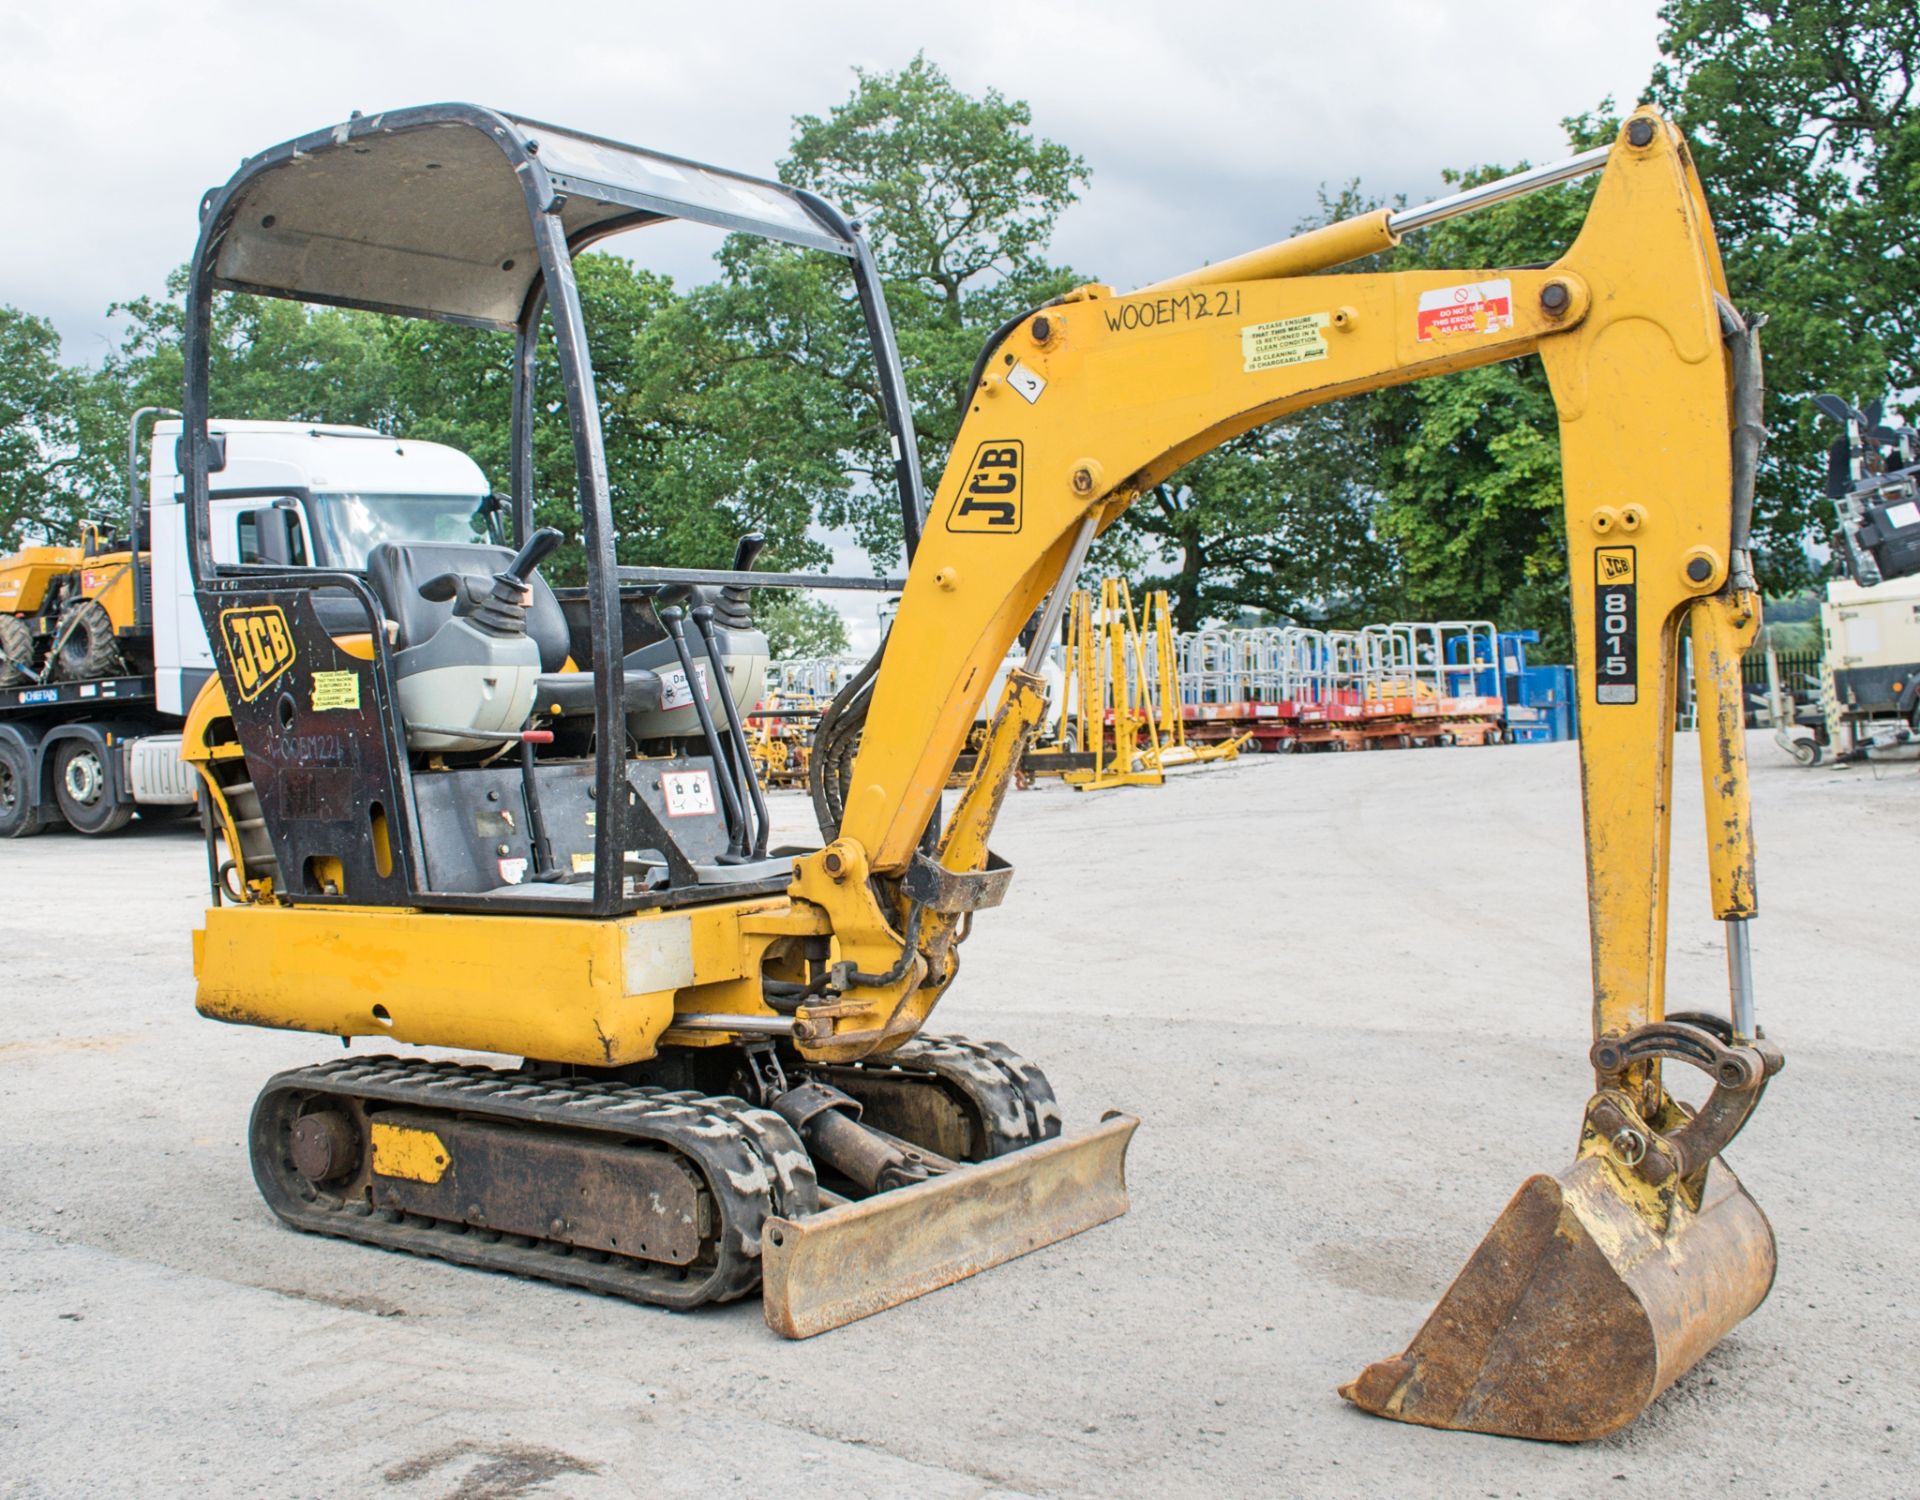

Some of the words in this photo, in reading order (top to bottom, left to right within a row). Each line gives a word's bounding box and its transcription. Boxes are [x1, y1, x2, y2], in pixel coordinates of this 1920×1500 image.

[1252, 331, 1269, 339] THAT
[1288, 322, 1318, 332] MACHINE
[1258, 322, 1283, 331] PLEASE
[1285, 317, 1311, 326] ENSURE
[1256, 344, 1278, 352] CLEAN
[1280, 337, 1317, 348] CONDITION
[1264, 333, 1300, 343] RETURNED
[1257, 356, 1301, 368] CHARGEABLE
[1263, 350, 1297, 360] CLEANING
[958, 448, 1017, 525] JCB
[1606, 557, 1629, 577] JCB
[1605, 593, 1627, 676] 8015
[231, 615, 289, 689] JCB
